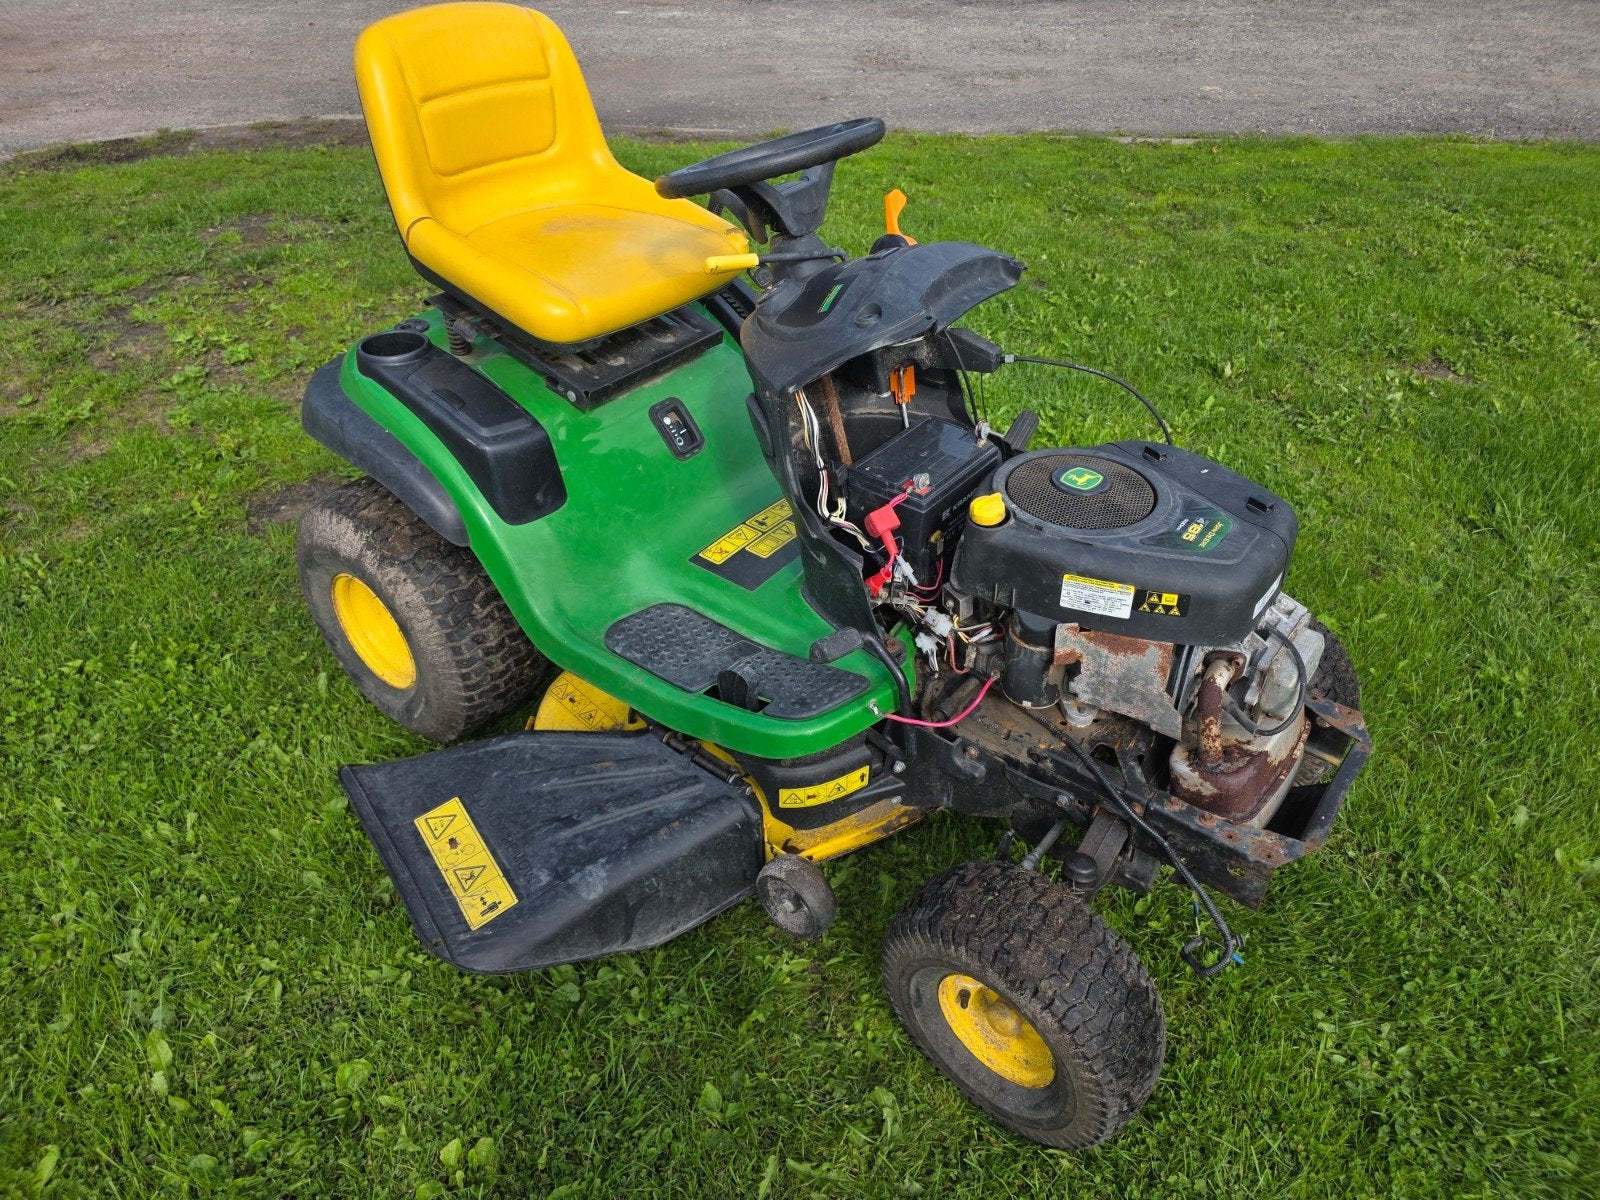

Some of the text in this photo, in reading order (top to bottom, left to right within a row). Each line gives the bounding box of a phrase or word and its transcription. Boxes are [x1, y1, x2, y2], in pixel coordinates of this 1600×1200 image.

[1198, 531, 1216, 548] DEERE
[471, 788, 541, 888] DO NOT REMOVE
